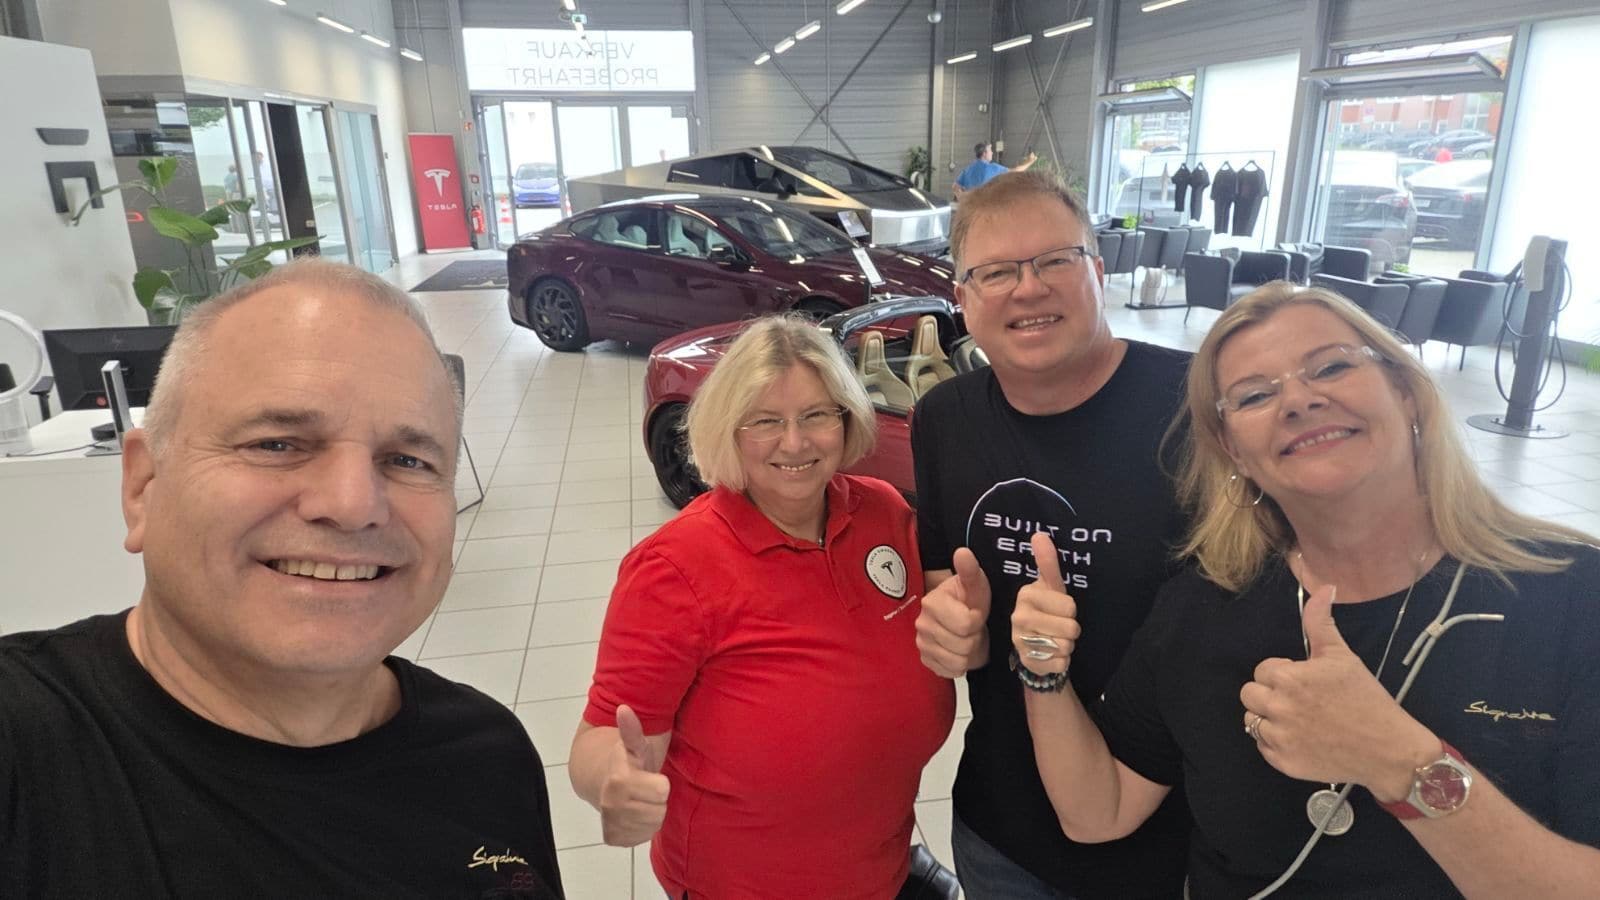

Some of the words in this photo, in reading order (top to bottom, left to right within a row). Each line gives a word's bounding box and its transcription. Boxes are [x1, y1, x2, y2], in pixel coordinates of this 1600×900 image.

[427, 203, 457, 211] TESLA
[984, 513, 1059, 538] BUILT
[1071, 528, 1112, 543] ON
[997, 537, 1091, 566] EATH
